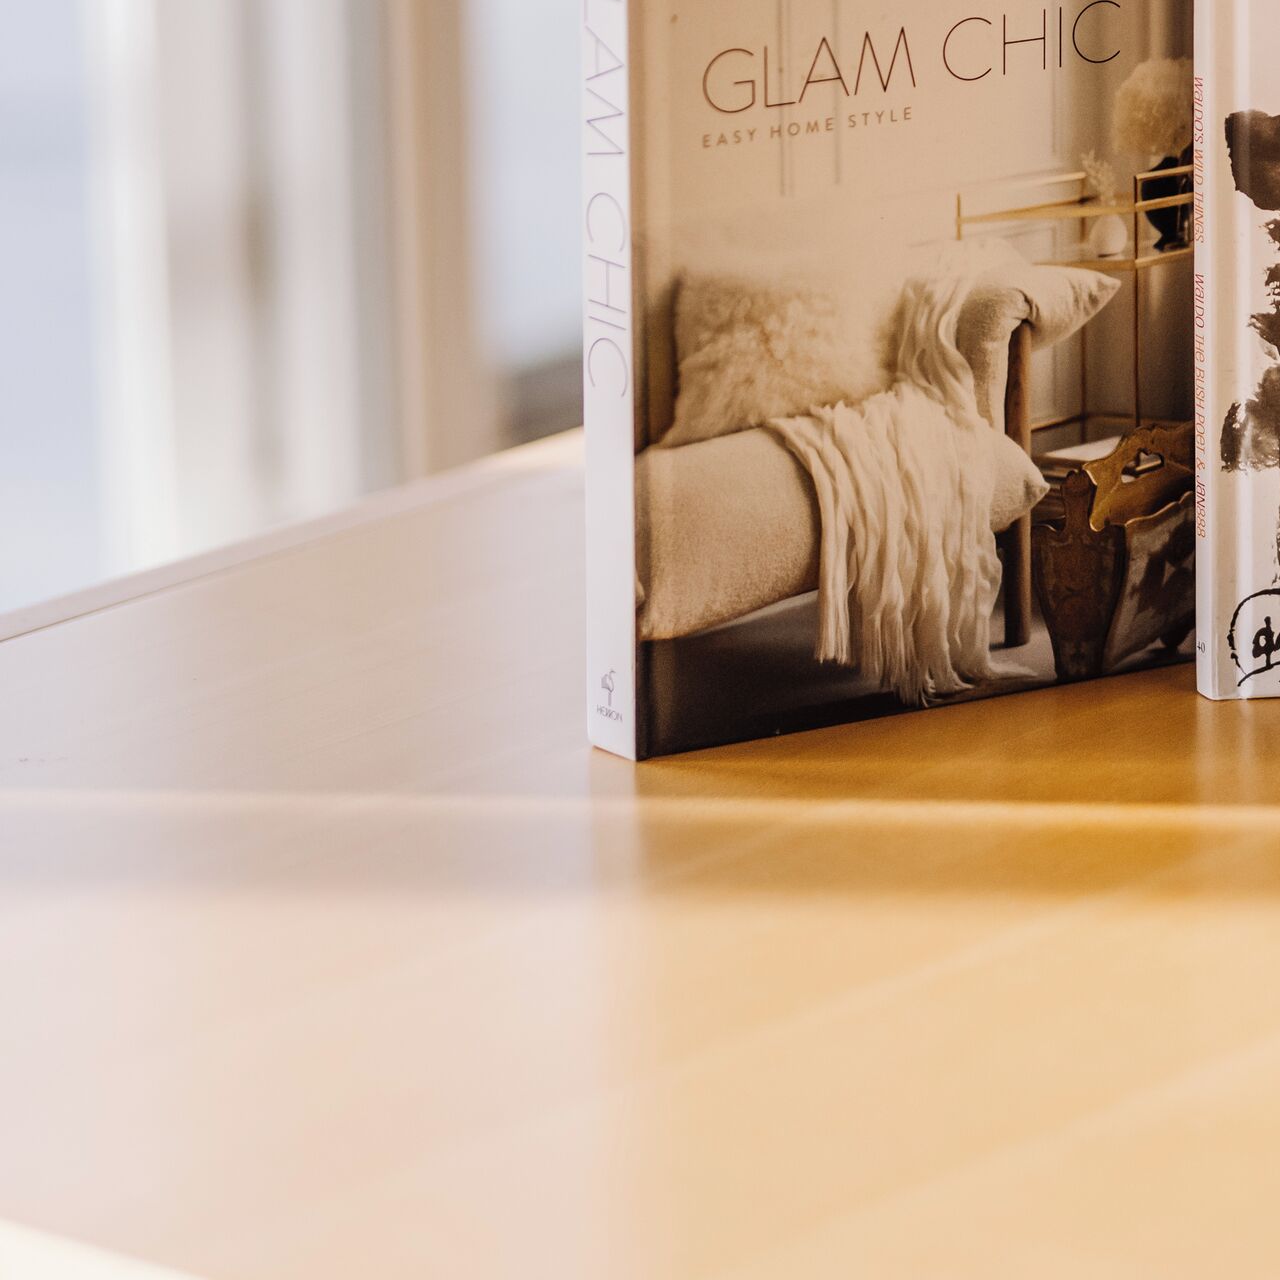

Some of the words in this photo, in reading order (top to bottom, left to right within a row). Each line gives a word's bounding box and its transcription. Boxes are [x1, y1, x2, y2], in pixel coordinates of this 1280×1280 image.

[702, 26, 916, 114] GLAM
[942, 0, 1122, 82] CHIC
[702, 128, 757, 149] EASY
[769, 117, 835, 139] HOME
[848, 106, 913, 129] STYLE
[585, 192, 629, 398] CHIC
